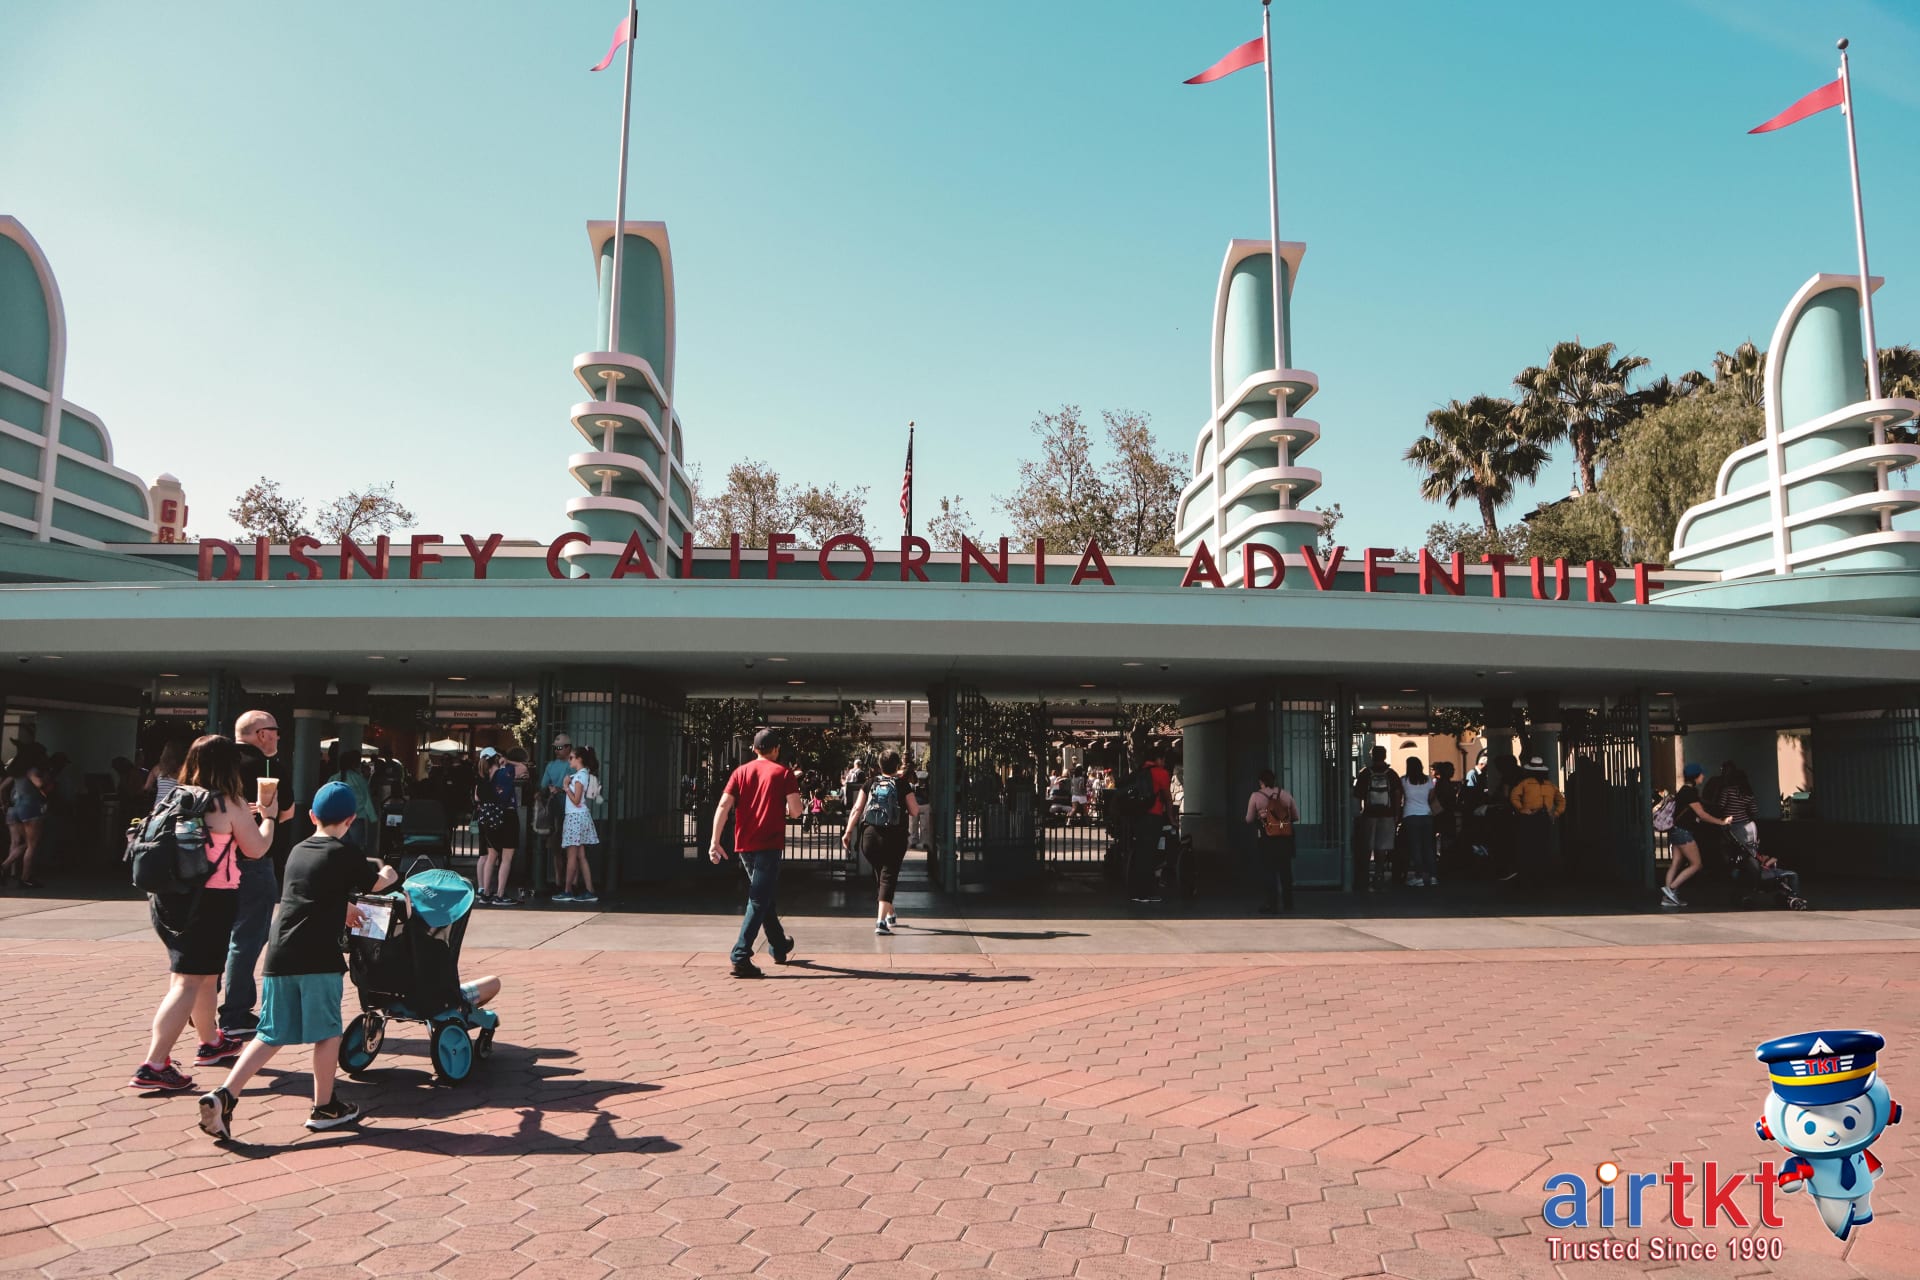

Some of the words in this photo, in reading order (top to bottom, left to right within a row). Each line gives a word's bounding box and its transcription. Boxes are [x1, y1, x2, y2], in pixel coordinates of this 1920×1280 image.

[197, 533, 502, 581] DISNEY
[546, 529, 1116, 586] CALIFORNIA
[1180, 539, 1665, 605] ADVENTURE
